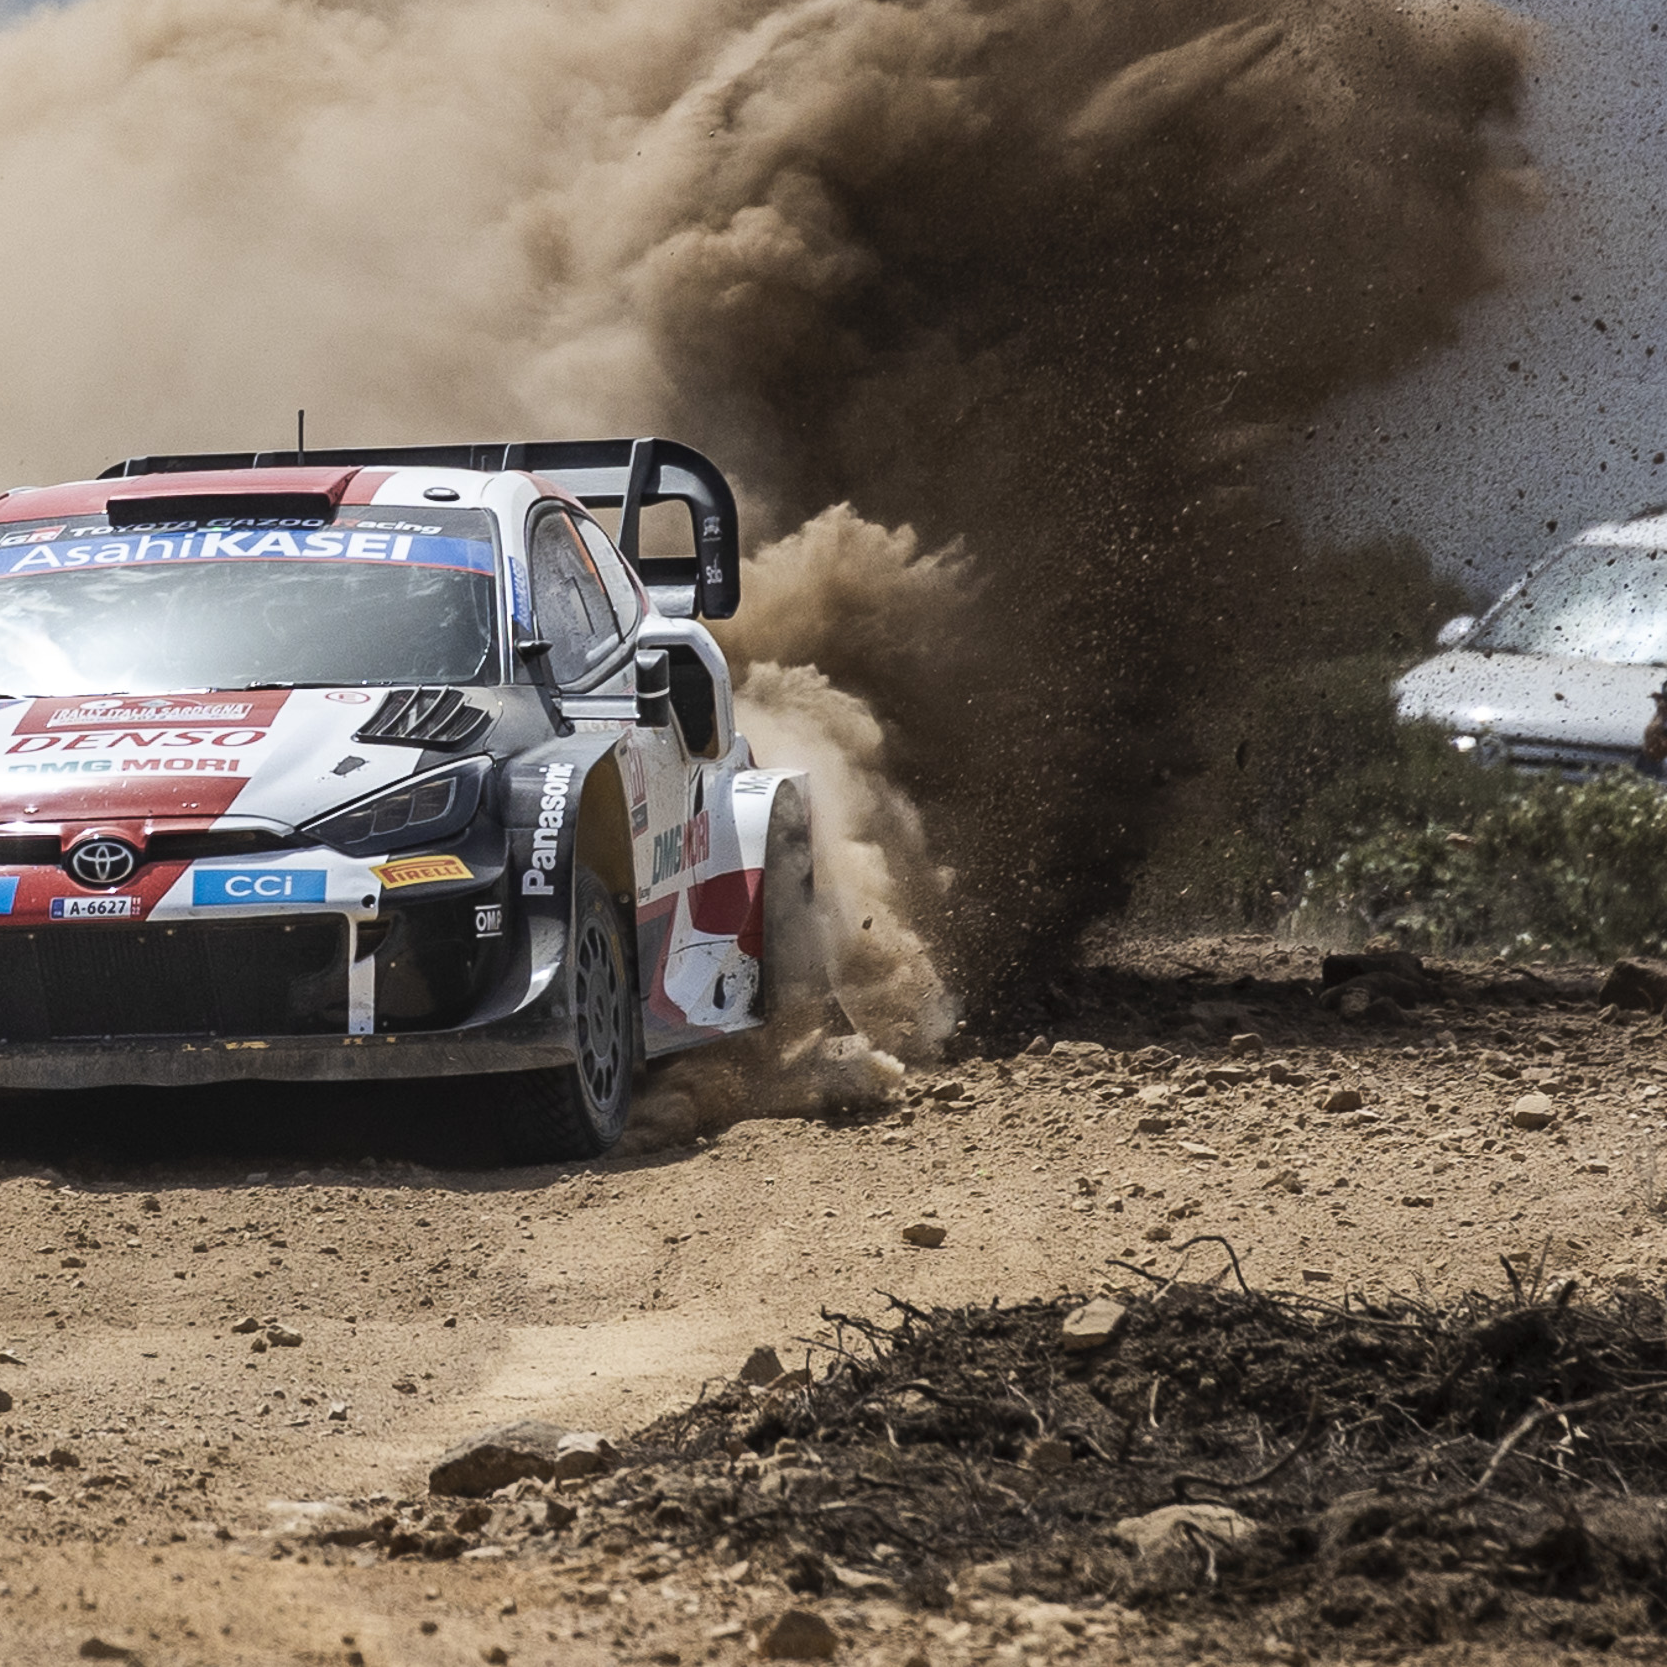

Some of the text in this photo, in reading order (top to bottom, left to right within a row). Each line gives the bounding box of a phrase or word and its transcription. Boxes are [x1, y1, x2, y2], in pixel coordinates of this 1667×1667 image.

[2, 517, 443, 546] GR TOYOTA GAZOO Racing
[55, 708, 106, 721] RALLY
[107, 707, 158, 719] ITALIA
[160, 703, 246, 717] SARDEGNA
[5, 730, 268, 755] DENSO
[121, 758, 241, 772] MORI
[521, 762, 575, 896] Panasonic
[378, 859, 463, 883] PIRELLI
[69, 900, 127, 916] A-6627
[475, 910, 503, 932] OMP
